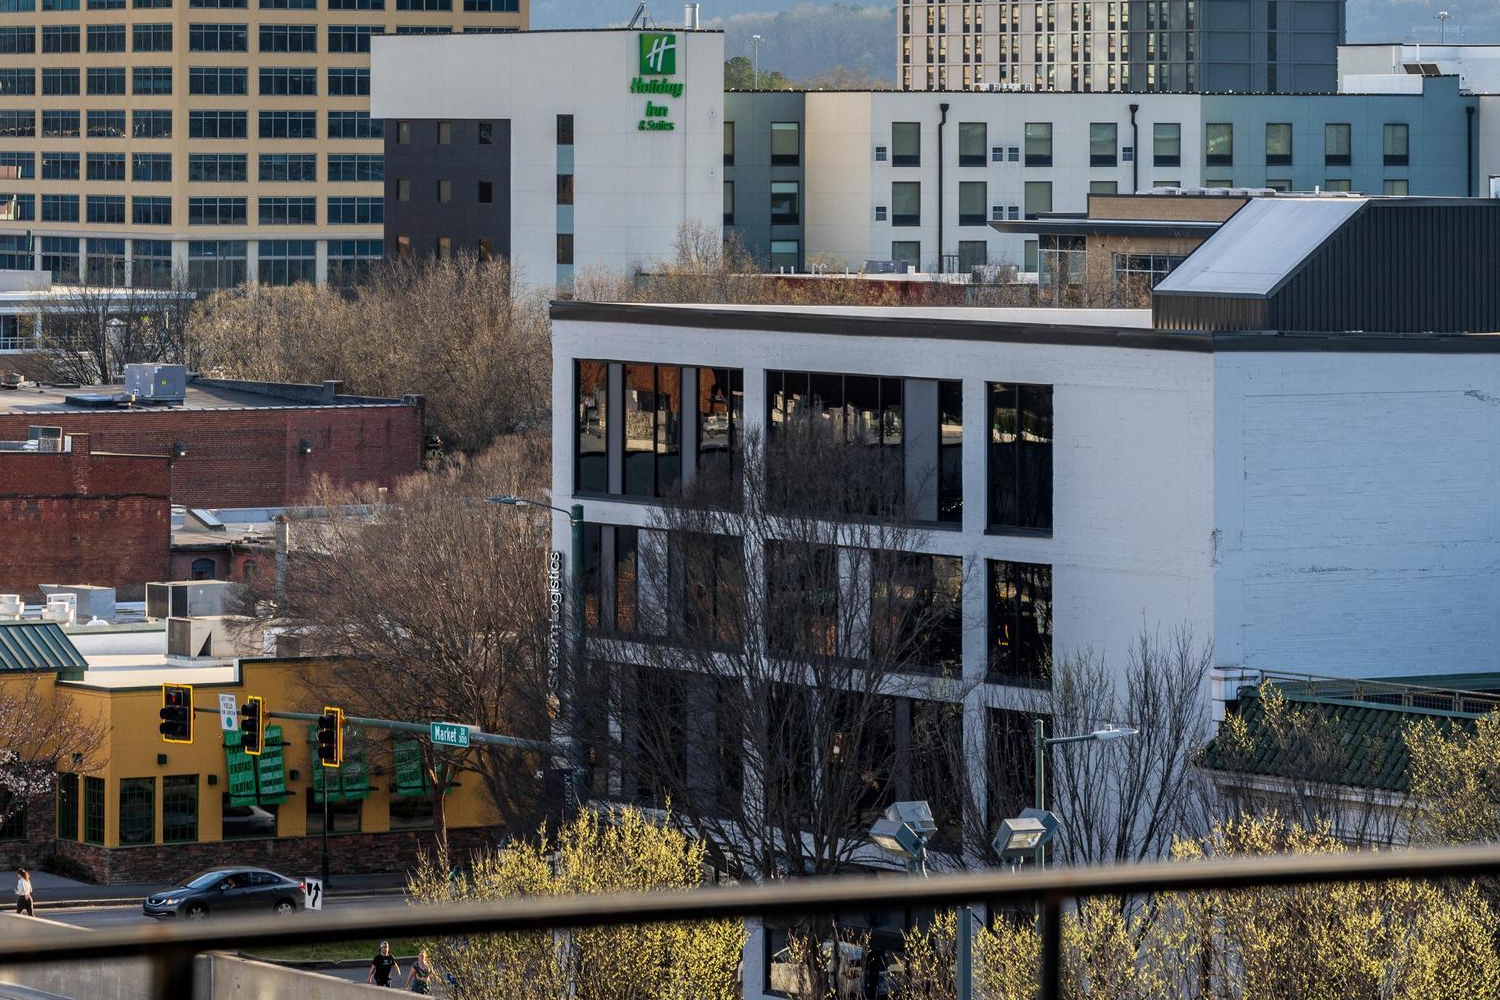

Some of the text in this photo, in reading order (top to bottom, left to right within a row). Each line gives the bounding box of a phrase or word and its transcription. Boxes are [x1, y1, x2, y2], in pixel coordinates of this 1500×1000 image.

[630, 76, 685, 99] Holiday
[645, 100, 669, 118] Inn
[646, 120, 675, 131] Suites
[434, 726, 457, 743] Market
[460, 727, 466, 736] St
[458, 734, 468, 744] 300
